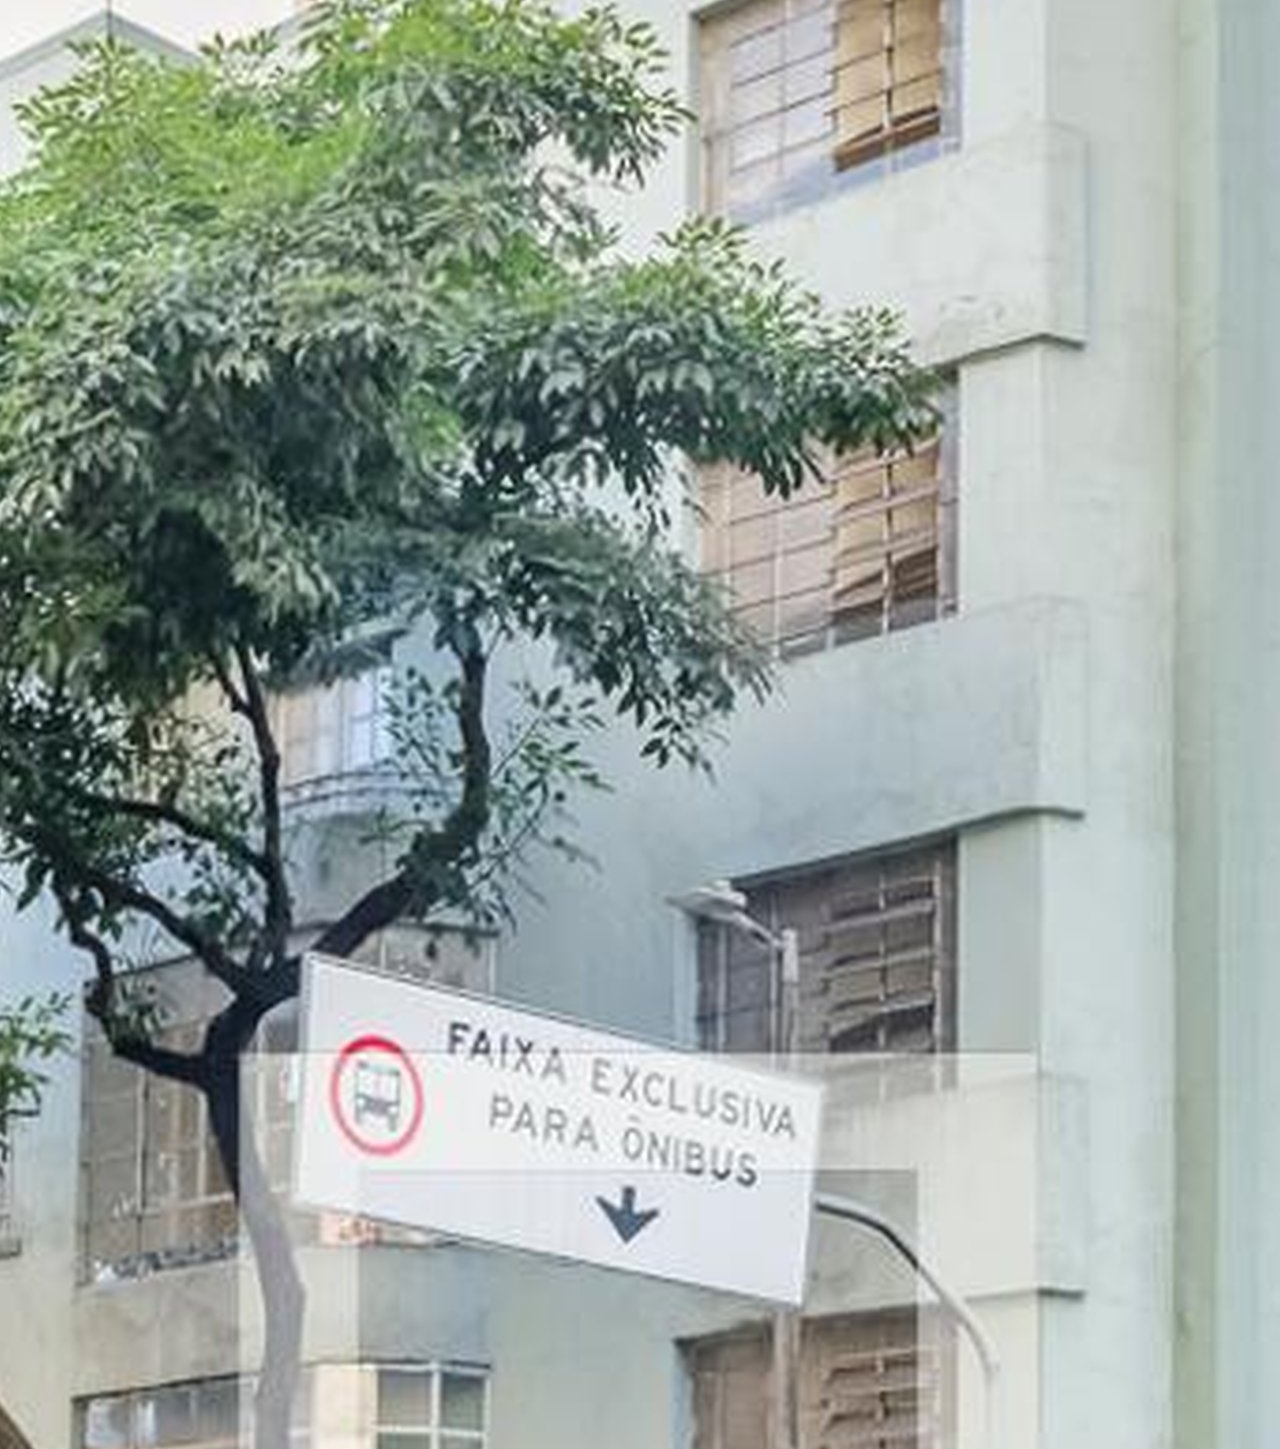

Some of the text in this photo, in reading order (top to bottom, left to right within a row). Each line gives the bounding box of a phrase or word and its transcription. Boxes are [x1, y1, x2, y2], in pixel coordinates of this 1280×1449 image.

[447, 1021, 796, 1139] FAIXA EXCLUSIVA
[489, 1092, 757, 1187] PARA ÔNIBUS
